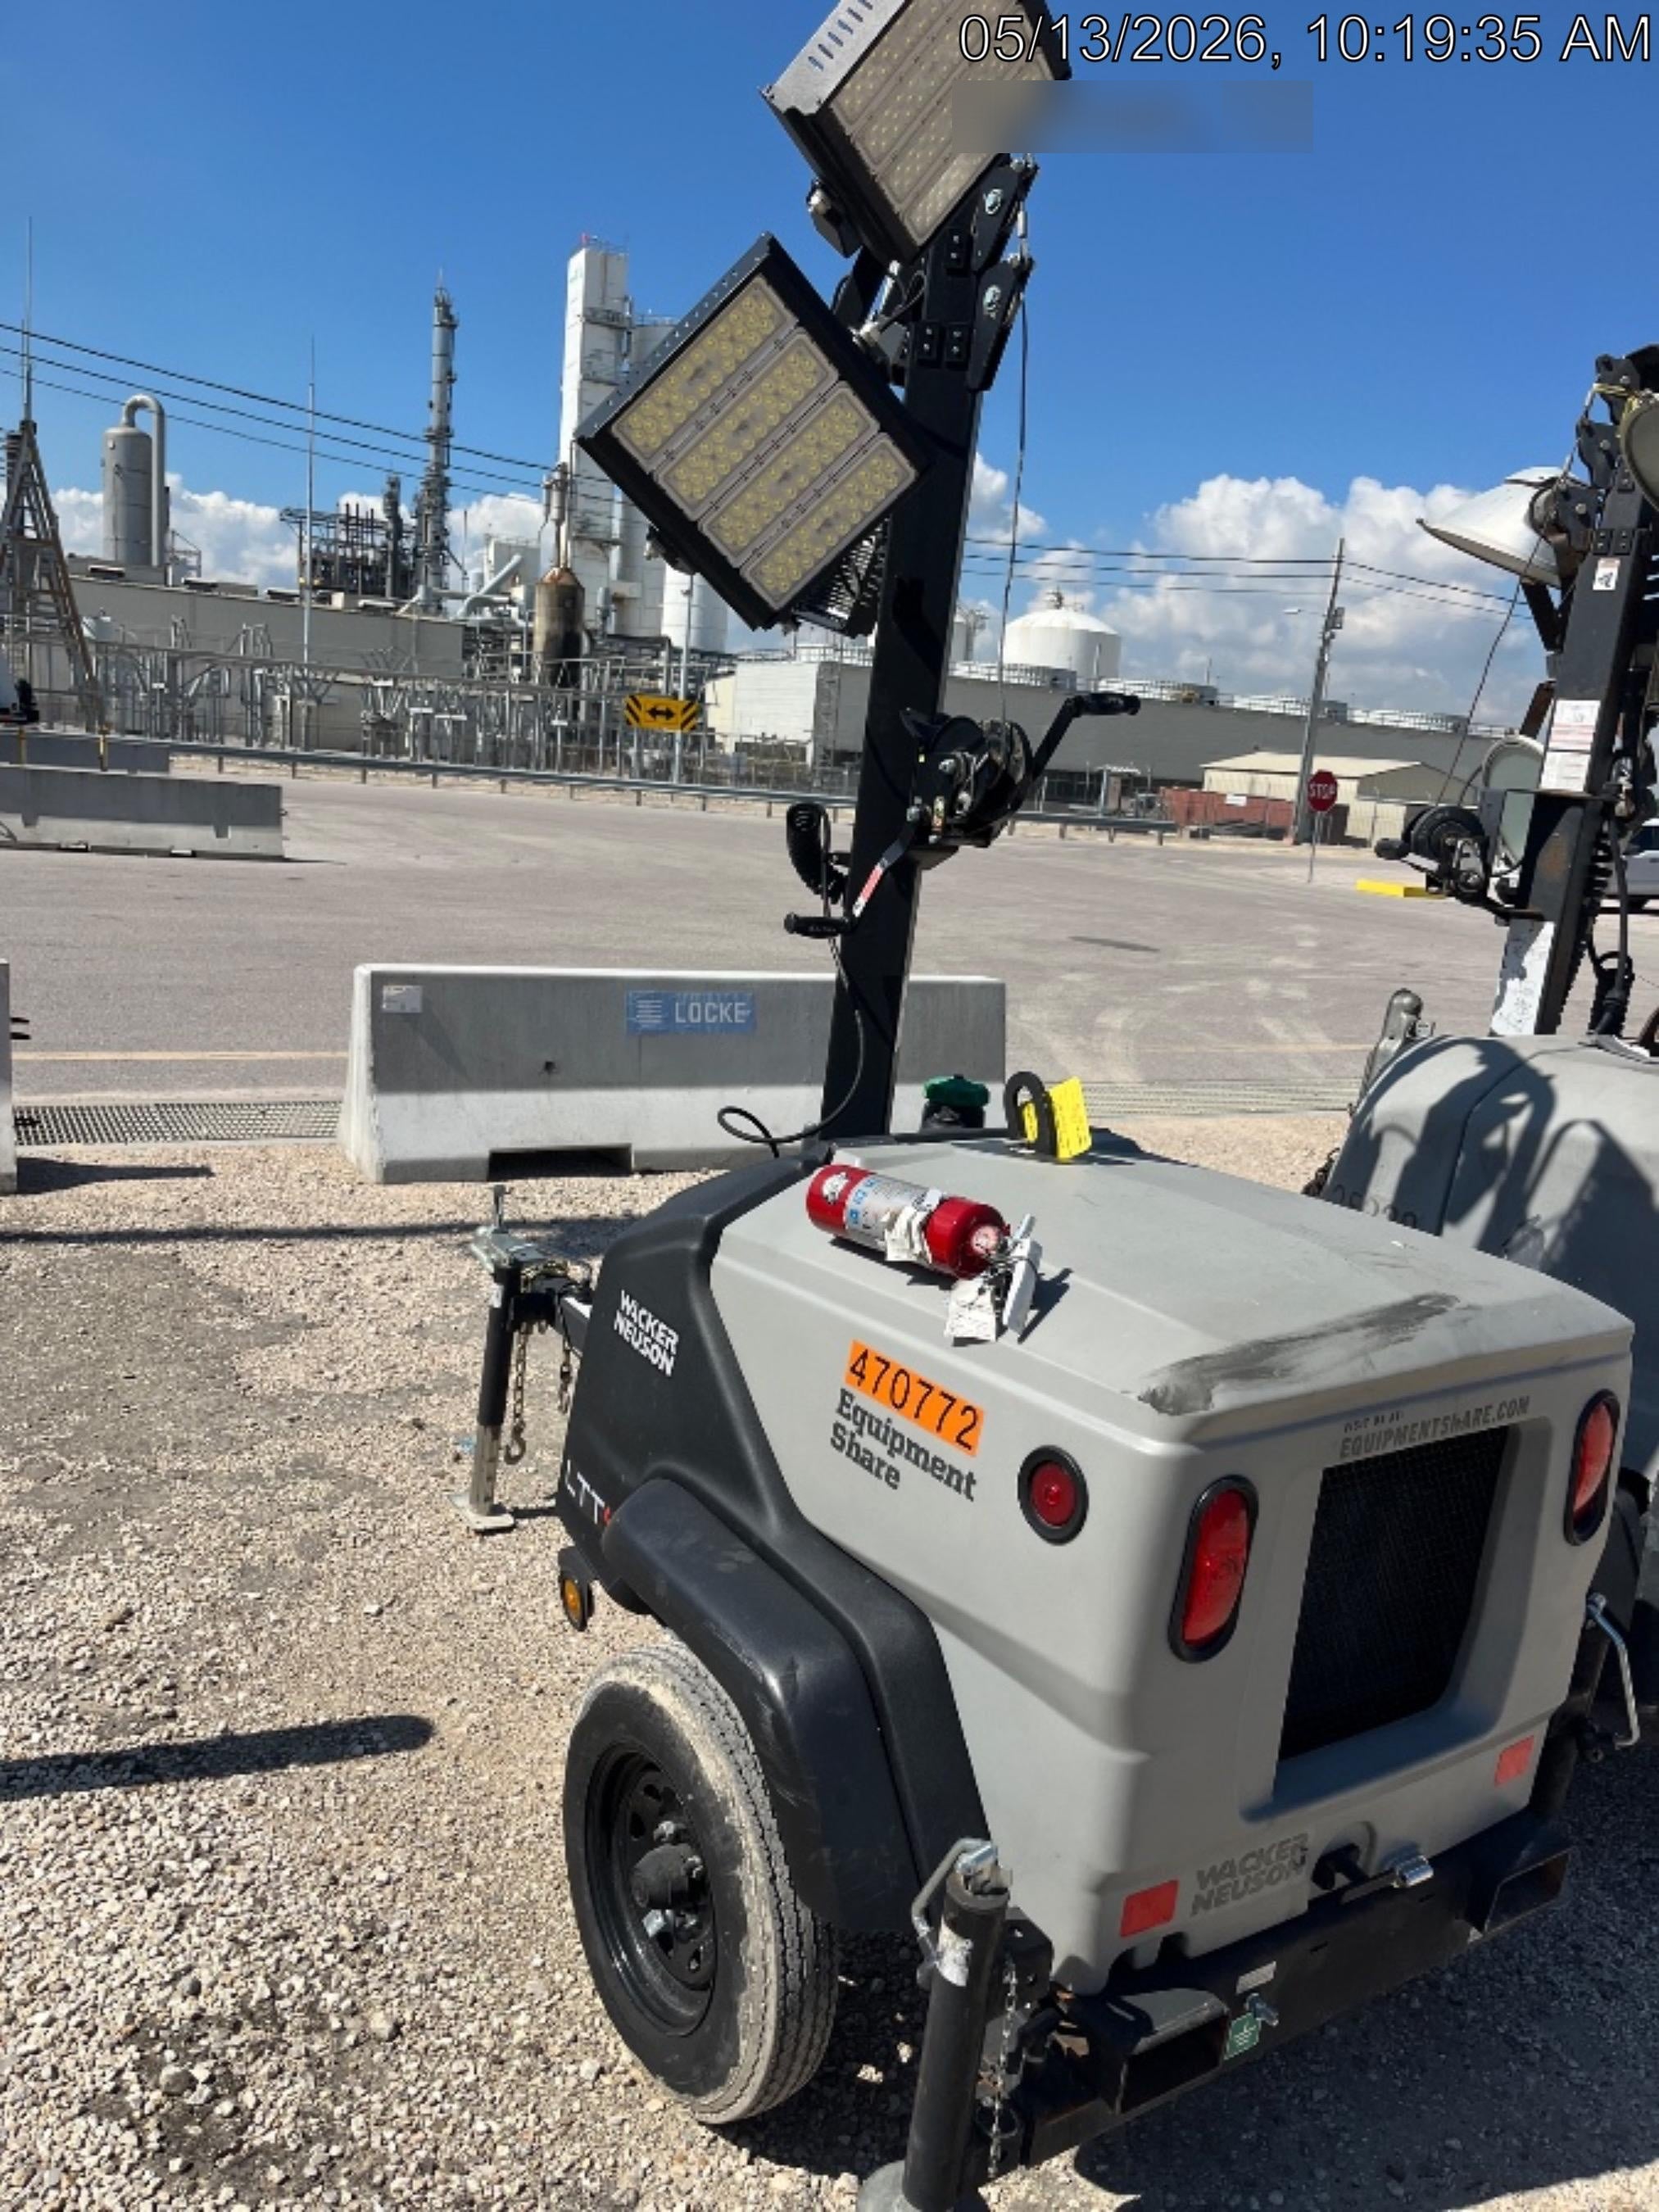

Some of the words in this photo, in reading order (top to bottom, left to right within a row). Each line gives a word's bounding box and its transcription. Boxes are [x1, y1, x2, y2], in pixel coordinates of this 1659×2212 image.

[674, 1002, 747, 1023] LOCKE
[614, 1309, 675, 1376] NEUSON
[620, 1289, 679, 1355] WACKER
[849, 1349, 980, 1450] 470772
[1339, 1394, 1530, 1459] EQUIPMENTSHARE.COM
[831, 1421, 900, 1490] Share
[836, 1389, 977, 1502] Equipment
[1195, 1833, 1308, 1890] WACKER
